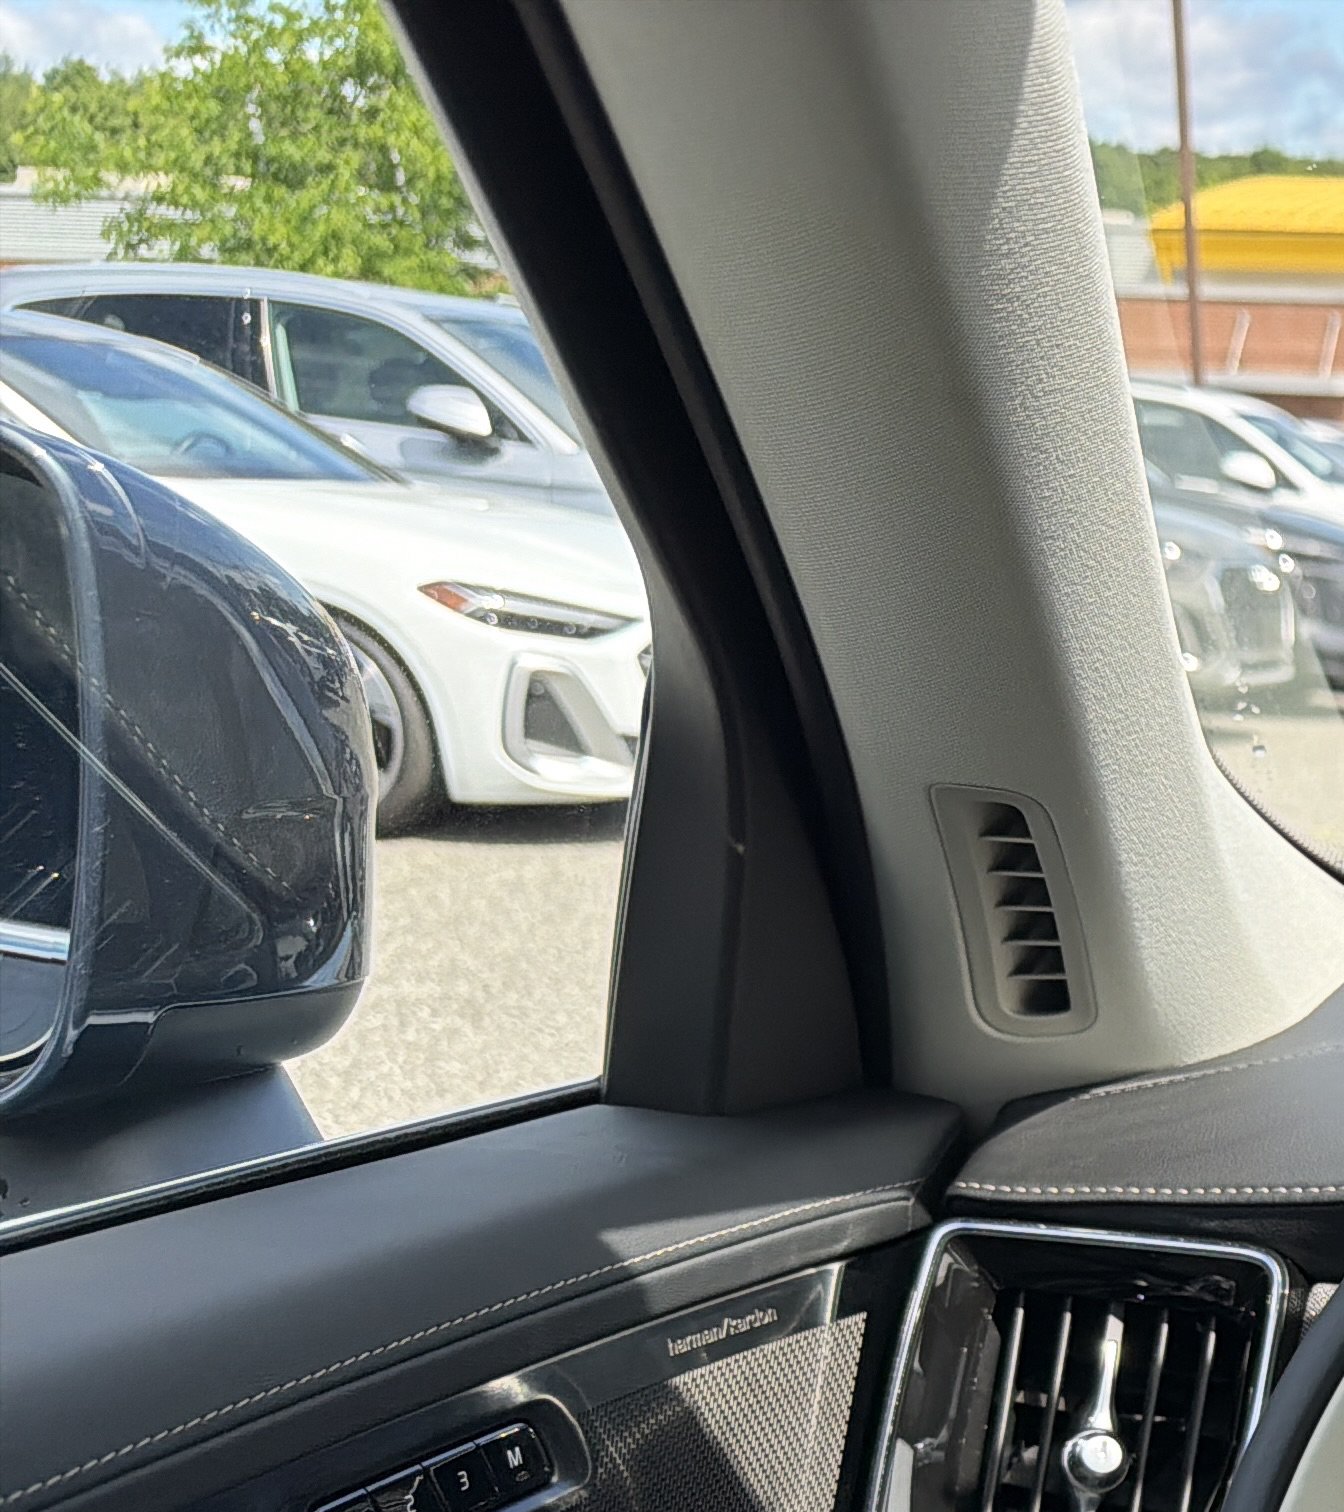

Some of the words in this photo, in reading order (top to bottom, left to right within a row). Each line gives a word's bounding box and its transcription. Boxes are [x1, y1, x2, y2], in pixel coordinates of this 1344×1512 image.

[667, 1308, 778, 1357] harman/kardon
[456, 1470, 470, 1491] 3
[506, 1446, 524, 1469] M
